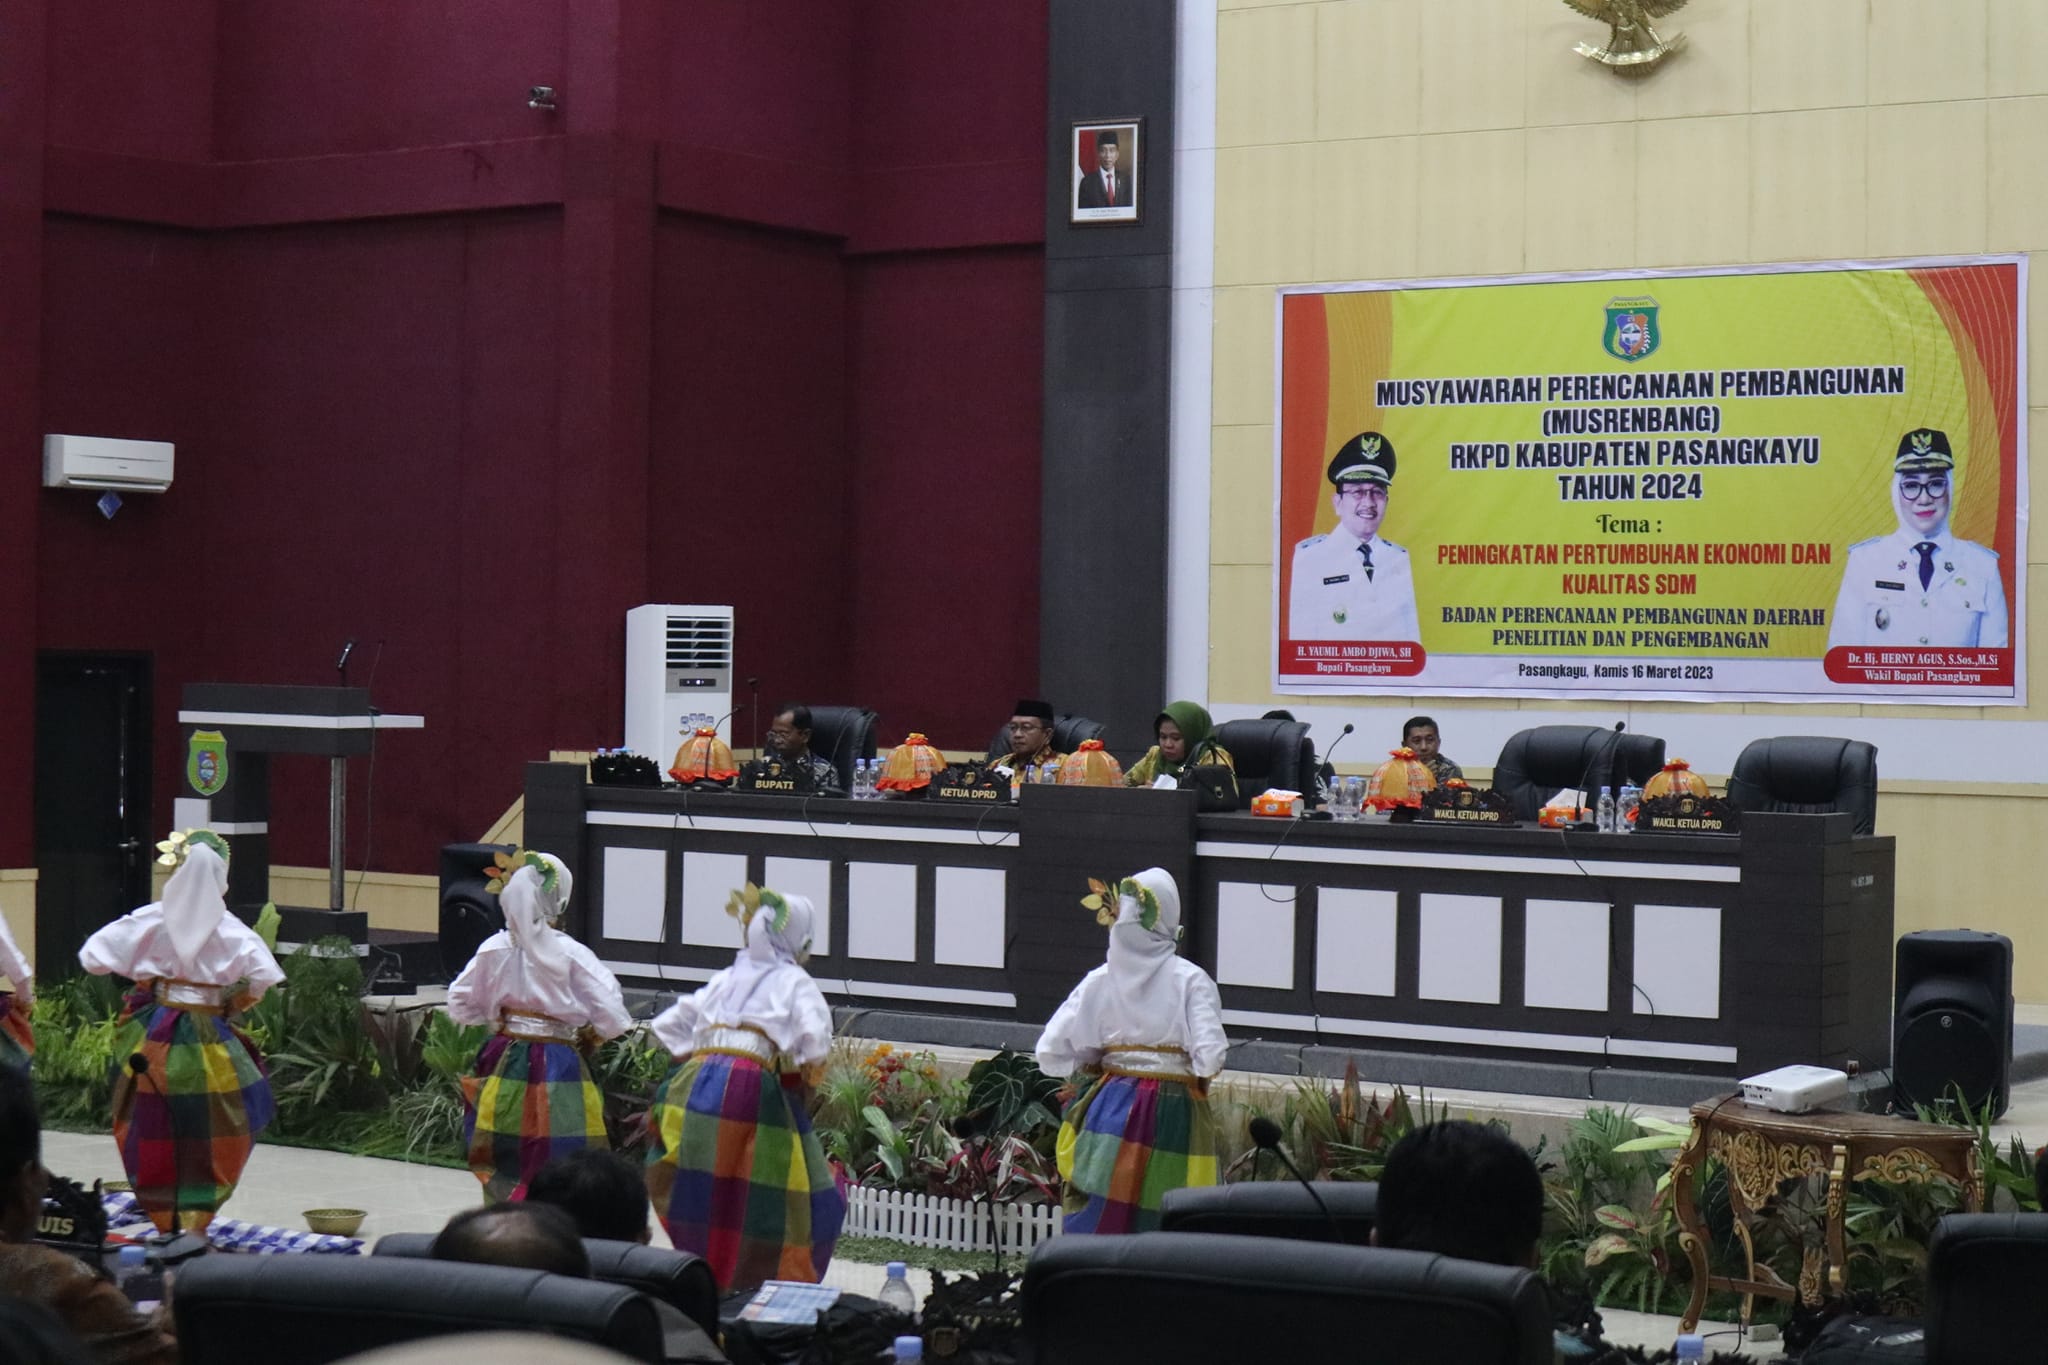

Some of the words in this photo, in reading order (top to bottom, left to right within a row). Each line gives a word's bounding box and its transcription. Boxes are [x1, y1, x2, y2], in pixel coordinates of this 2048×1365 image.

[1377, 377, 1542, 406] MUSYAWARAH
[1548, 372, 1714, 401] PERENCANAAN
[1720, 367, 1904, 397] PEMBANGUNAN
[1543, 406, 1720, 436] (MUSRENBANG)
[1451, 443, 1510, 468] RKPD
[1516, 440, 1650, 467] KABUPATEN
[1657, 438, 1819, 466] PASANGKAYU
[1558, 475, 1635, 500] TAHUN
[1642, 473, 1702, 499] 2024
[1596, 514, 1650, 533] Tema
[1438, 544, 1558, 565] PENINGKATAN
[1563, 543, 1699, 565] PERTUMBUHAN
[1704, 543, 1786, 565] EKONOMI
[1791, 543, 1831, 565] DAN
[1563, 574, 1649, 594] KUALITAS
[1655, 574, 1696, 594] SDM
[1442, 607, 1496, 623] BADAN
[1502, 607, 1617, 624] PERENCANAAN
[1622, 608, 1748, 625] PEMBANGUNAN
[1753, 609, 1825, 625] DAERAH
[1493, 629, 1587, 646] PENELITIAN
[1592, 630, 1626, 647] DAN
[1631, 631, 1769, 648] PENGEMBANGAN
[1298, 646, 1306, 657] H.
[1309, 646, 1340, 657] YAUMIL
[1341, 647, 1366, 657] AMBO
[1369, 647, 1397, 658] DJIWA,
[1400, 648, 1411, 657] SH
[1848, 653, 1861, 663] Dr.
[1865, 653, 1878, 665] Hj.
[1881, 653, 1915, 664] HERNY
[1917, 654, 1946, 666] AGUS,
[1317, 662, 1343, 673] Bupati
[1345, 662, 1391, 674] Pasangkayu
[1519, 663, 1589, 679] Pasangkayu,
[1594, 664, 1628, 678] Kamis
[1633, 665, 1643, 678] 16
[1646, 665, 1682, 679] Maret
[1685, 666, 1713, 679] 2023
[1865, 669, 1891, 681] Wakil
[1894, 670, 1924, 683] Bupati
[1927, 671, 1981, 684] Pasangkayu
[755, 780, 794, 790] BUPATI
[940, 788, 969, 798] KETUA
[971, 789, 997, 799] DPRD
[1434, 809, 1456, 819] WAKIL
[1457, 810, 1479, 820] KETUA
[1480, 811, 1499, 821] DPRD
[1652, 817, 1676, 828] WAKIL
[1677, 818, 1700, 829] KETUA
[1701, 819, 1722, 830] DPRD
